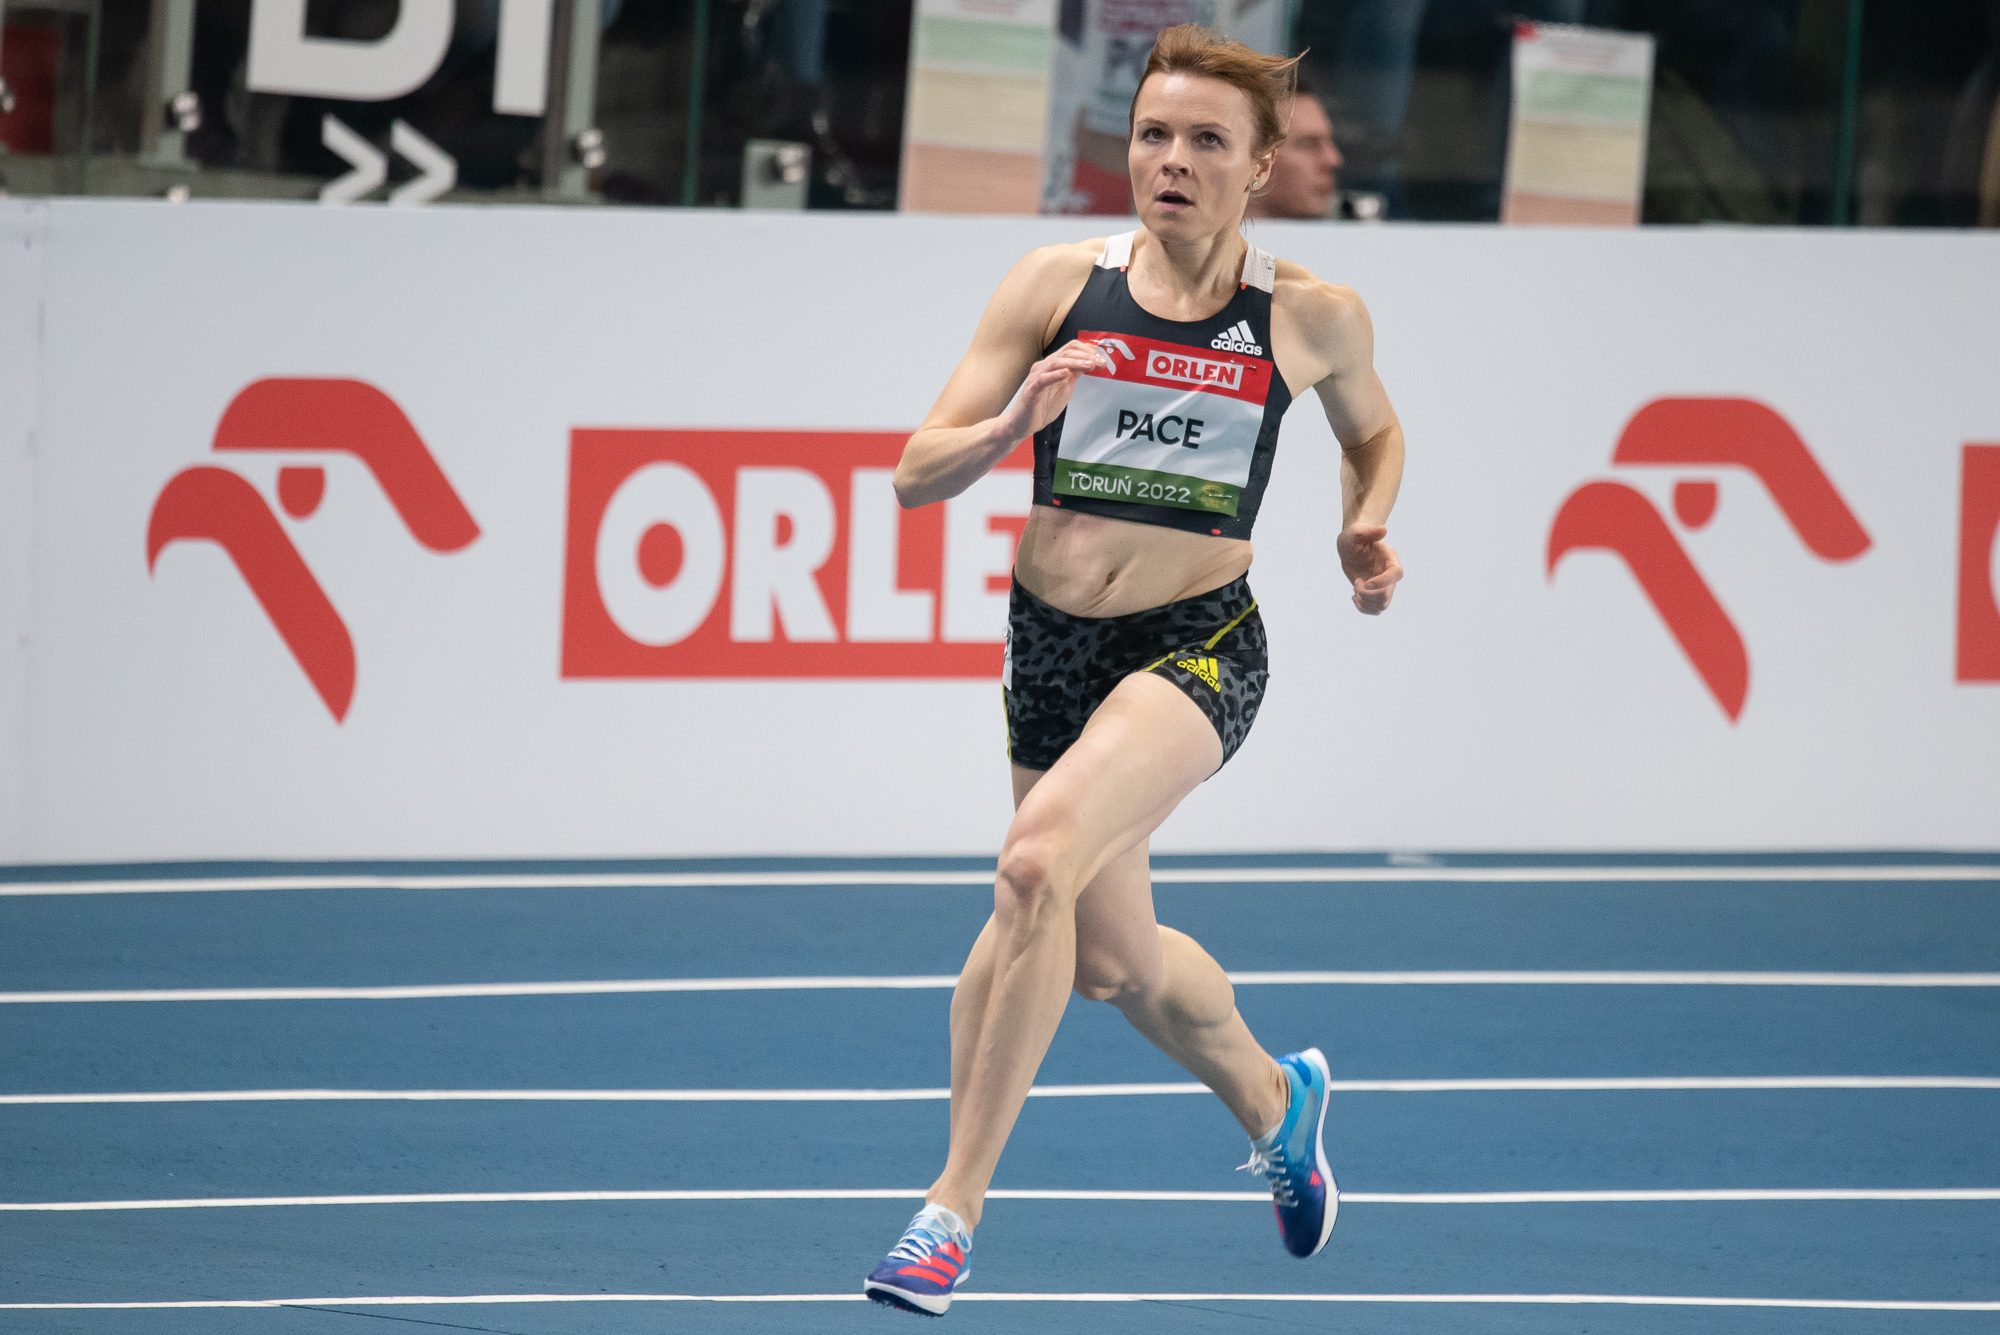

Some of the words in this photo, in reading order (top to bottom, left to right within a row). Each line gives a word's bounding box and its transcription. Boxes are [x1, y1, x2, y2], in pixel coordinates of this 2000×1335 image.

[1211, 338, 1263, 356] adidas
[1152, 355, 1237, 386] ORLEN
[1115, 409, 1205, 450] PACE
[1069, 473, 1132, 496] TORUŃ
[1137, 481, 1191, 504] 2022
[594, 460, 1034, 647] ORLE
[1176, 660, 1221, 693] adidas
